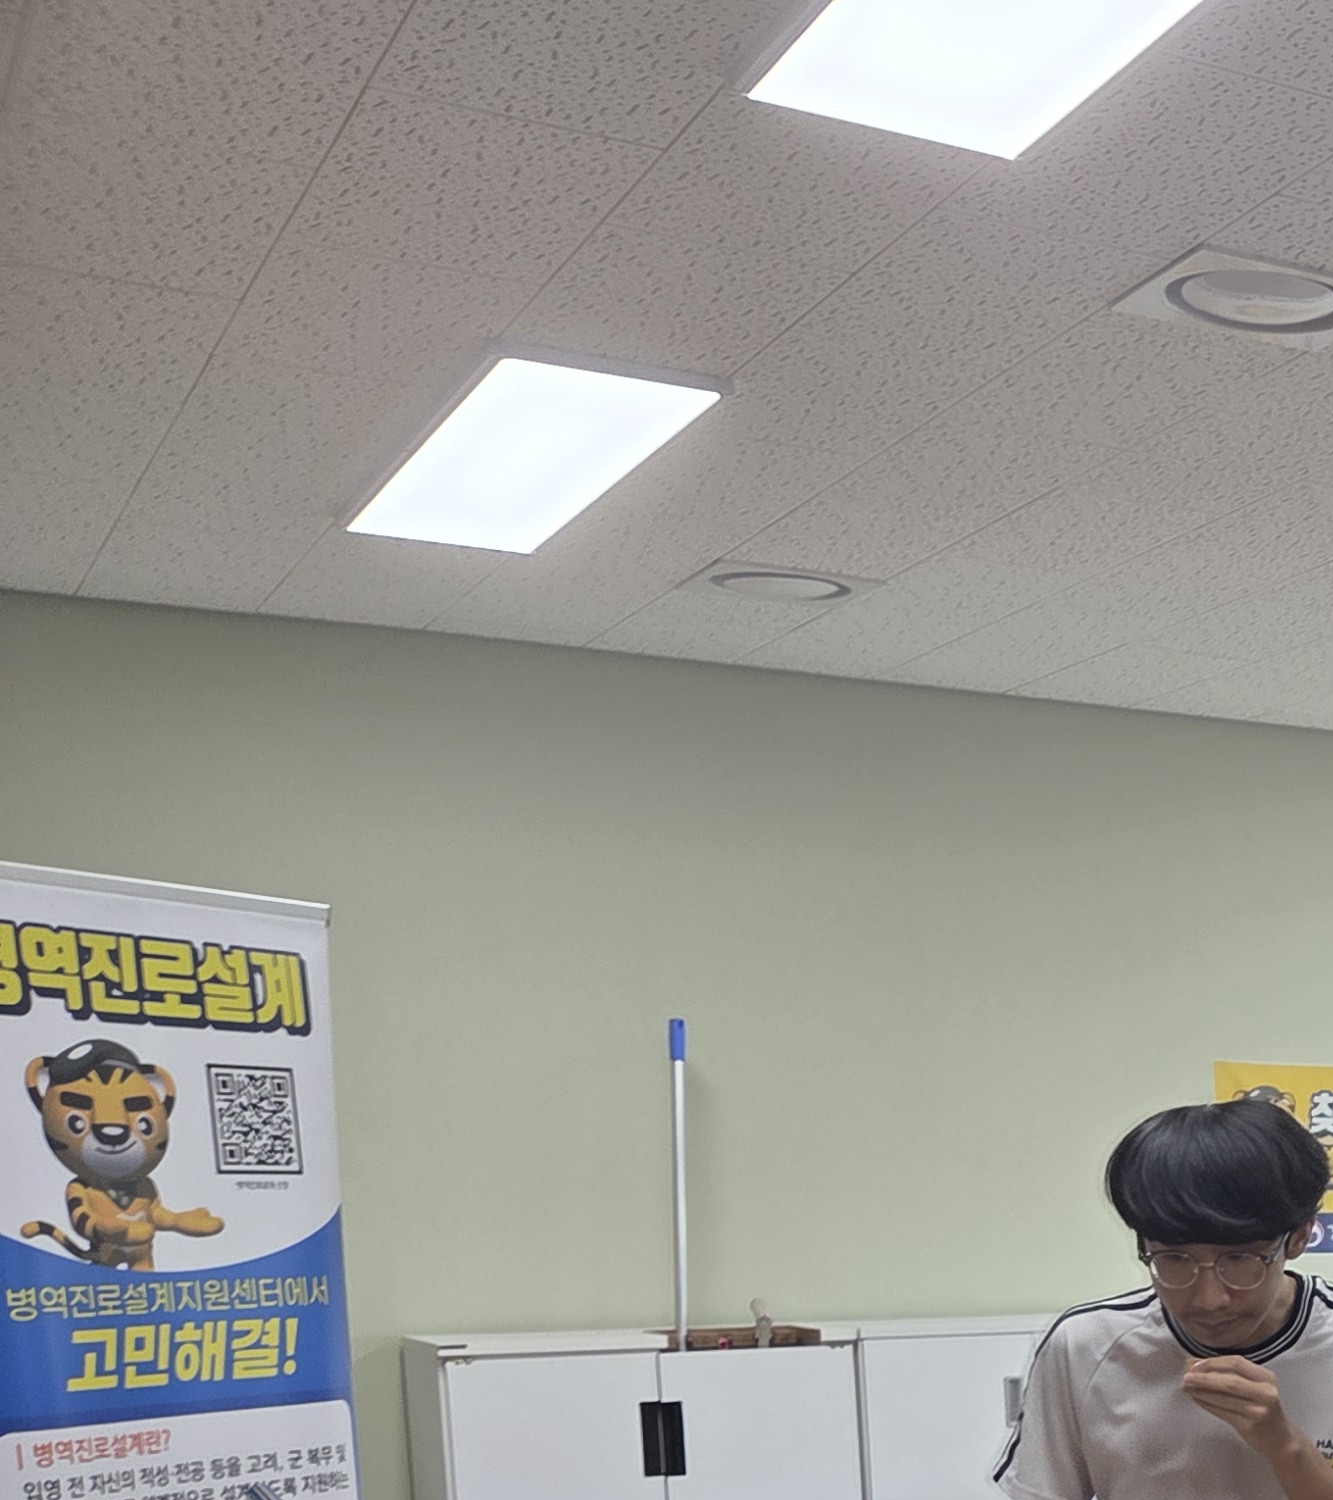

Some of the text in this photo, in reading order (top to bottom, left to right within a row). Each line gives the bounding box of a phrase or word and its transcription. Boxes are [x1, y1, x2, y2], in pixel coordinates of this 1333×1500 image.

[7, 1276, 328, 1321] 병역진로설계지원센터에서
[66, 1317, 299, 1392] 고민해결!
[33, 1429, 171, 1468] 병역진로설계란?
[67, 1476, 86, 1498] 전
[90, 1469, 136, 1495] 자신의
[210, 1456, 242, 1480] 등을
[246, 1451, 284, 1474] 고려,
[287, 1449, 304, 1470] 군
